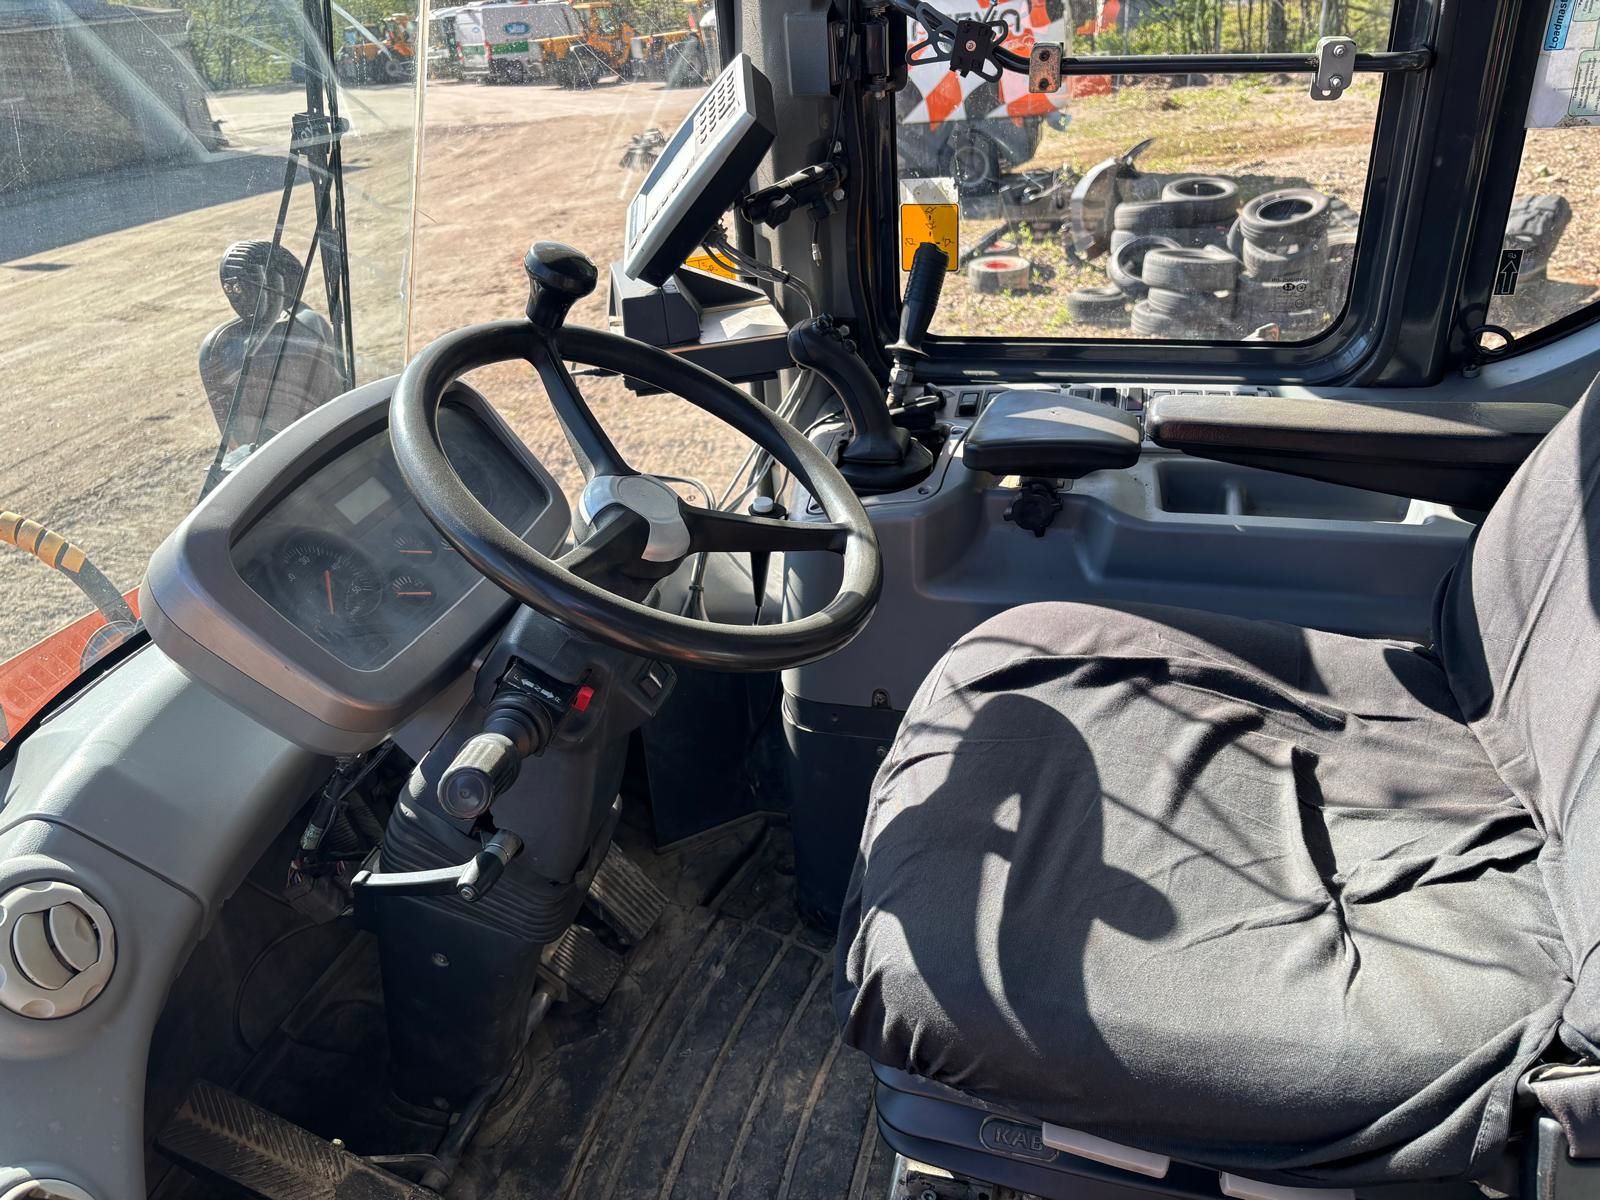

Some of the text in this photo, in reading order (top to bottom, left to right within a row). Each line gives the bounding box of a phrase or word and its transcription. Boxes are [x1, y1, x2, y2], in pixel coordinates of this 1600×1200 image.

[513, 673, 562, 704] F N R
[994, 1127, 1044, 1151] KAB
